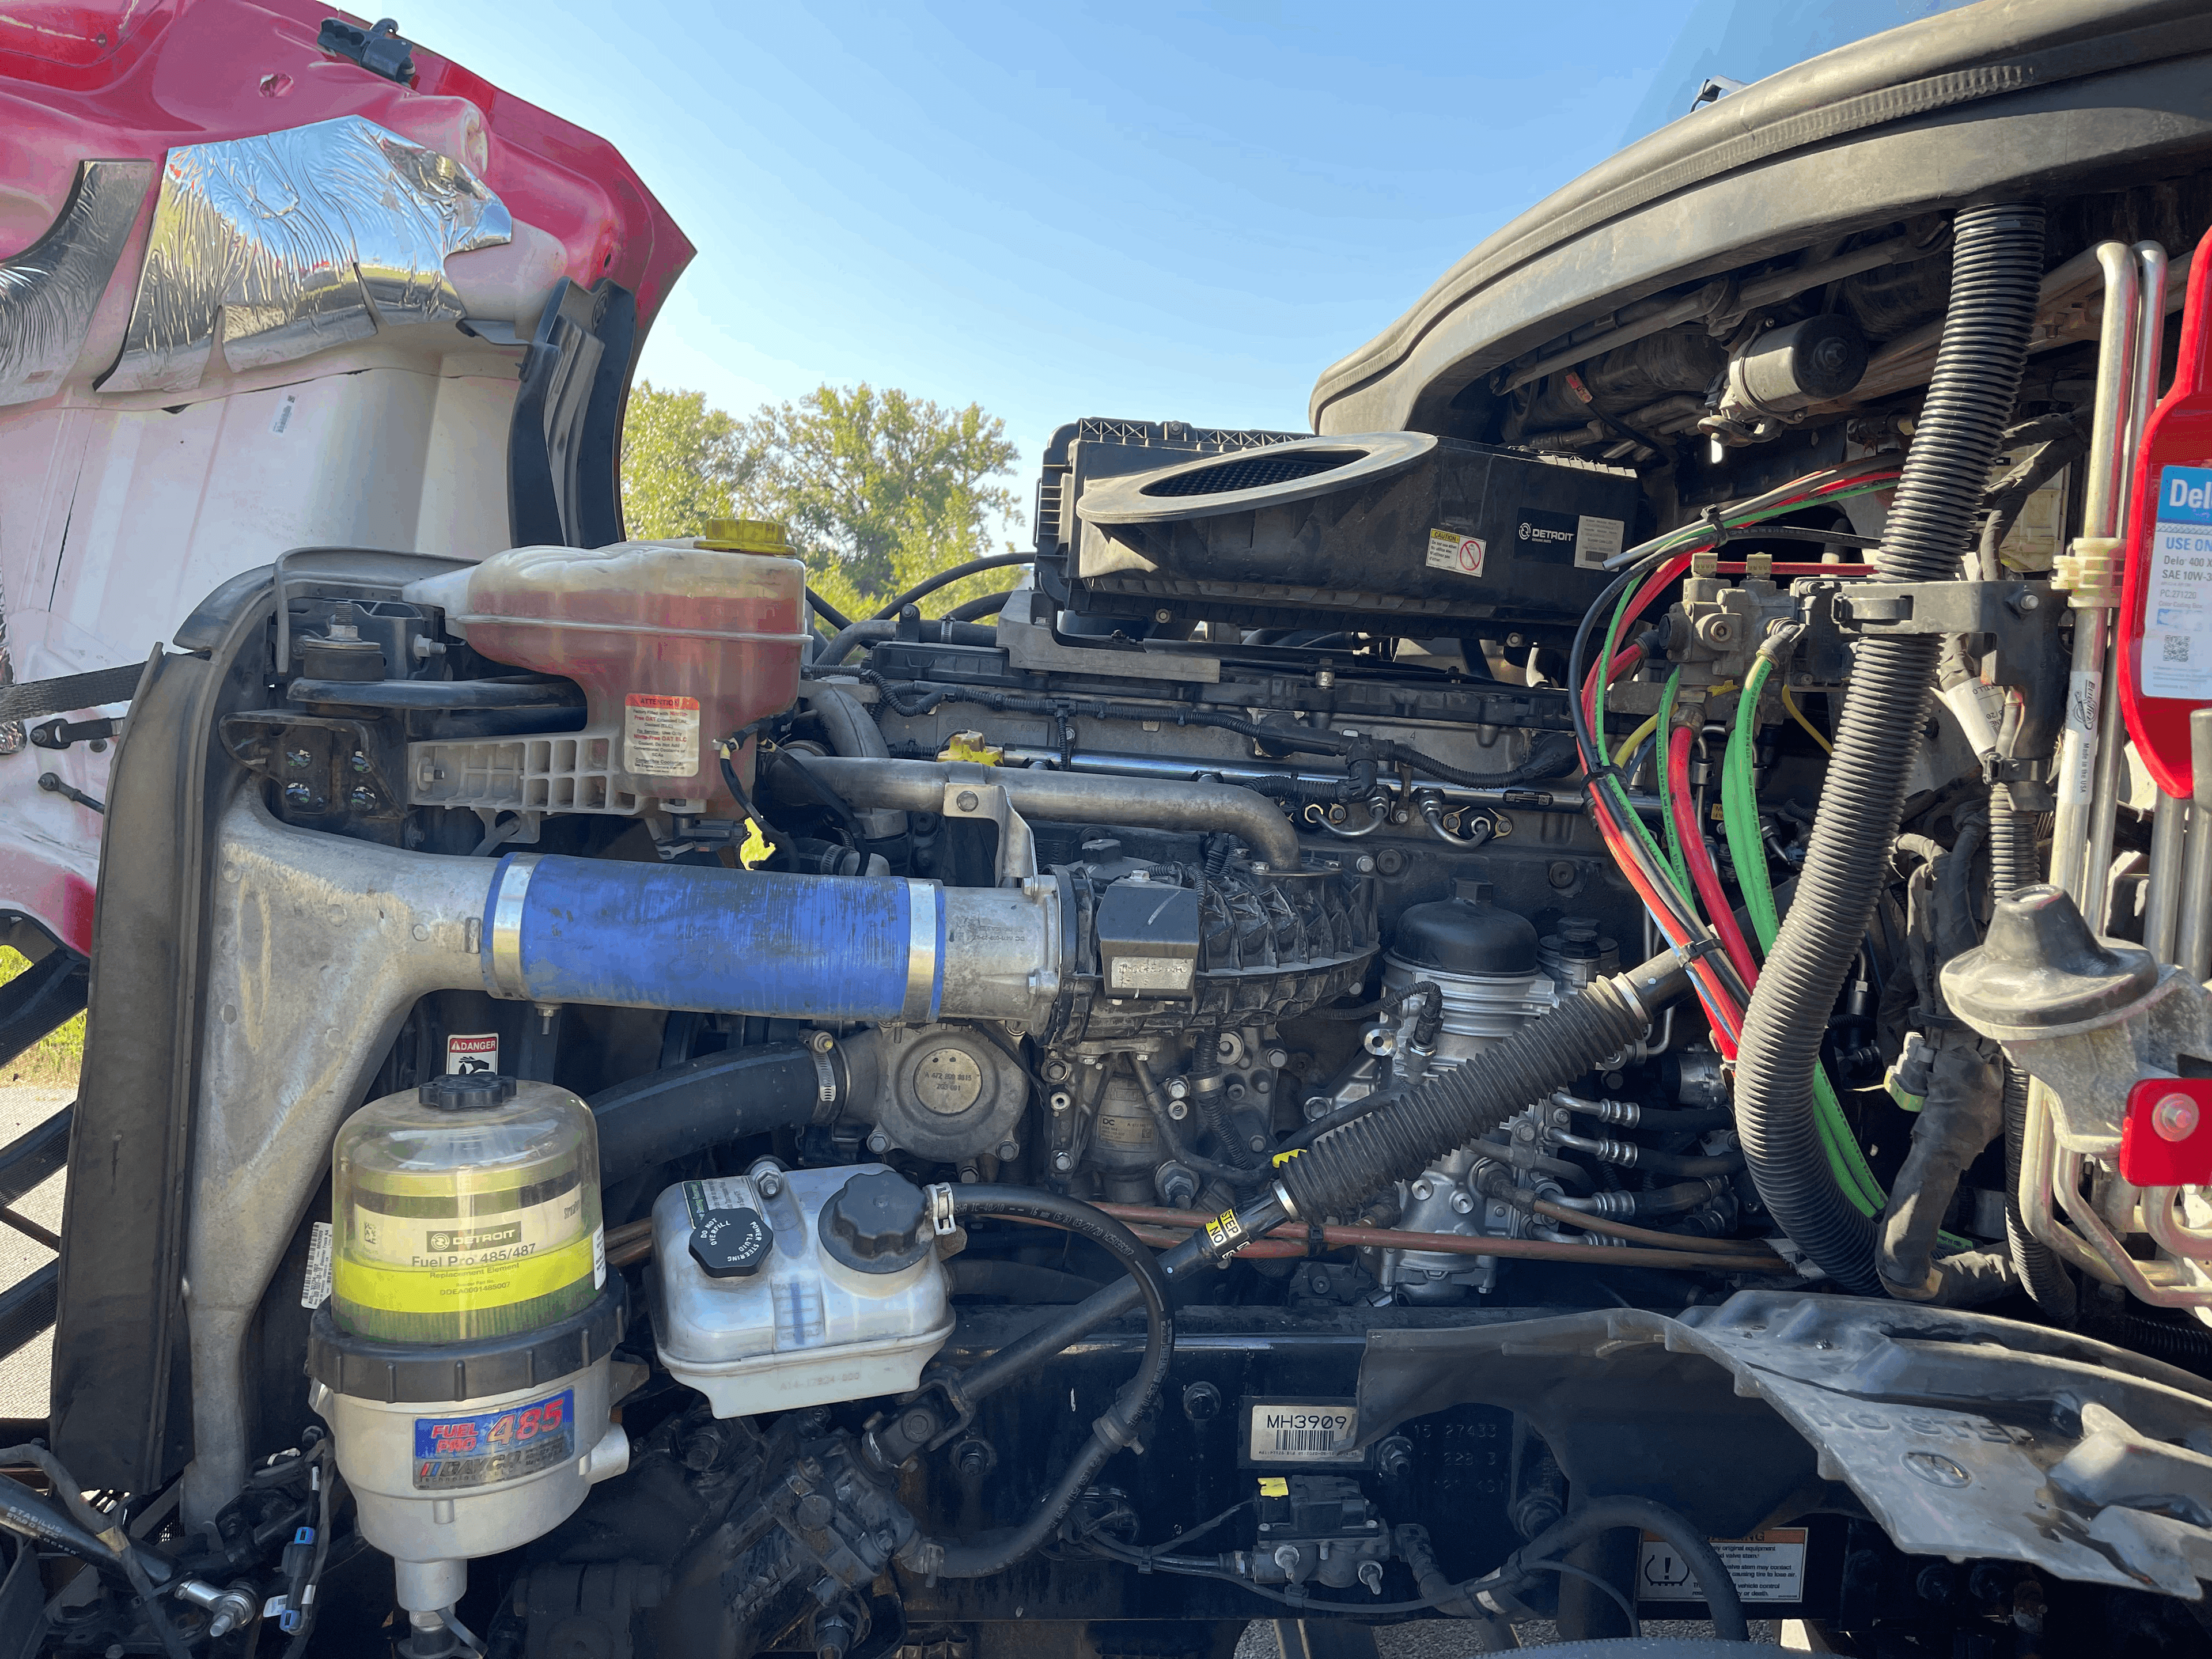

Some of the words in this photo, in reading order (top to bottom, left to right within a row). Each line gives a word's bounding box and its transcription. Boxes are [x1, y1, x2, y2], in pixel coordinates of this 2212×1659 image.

[1532, 528, 1575, 541] DETROIT
[2166, 537, 2191, 550] USE
[2189, 558, 2205, 567] 400
[2162, 569, 2181, 579] SAE
[461, 1040, 496, 1050] DANGER
[1103, 1118, 1115, 1126] DC
[700, 1230, 708, 1238] DO
[704, 1218, 718, 1229] NOT
[971, 1203, 1005, 1212] IC-40/10
[1052, 1211, 1072, 1225] (5/8)
[1072, 1219, 1103, 1237] 03/27/20
[1222, 1211, 1238, 1233] STEP
[453, 1229, 516, 1245] DETROIT
[709, 1220, 732, 1246] OVERFILL
[749, 1221, 762, 1241] POWER
[1210, 1226, 1224, 1243] NO
[738, 1233, 753, 1252] FLUID
[412, 1256, 442, 1268] Fuel
[448, 1256, 475, 1267] Pro
[480, 1243, 536, 1263] 485/487
[727, 1243, 759, 1262] STEERING
[430, 1269, 484, 1279] Replacement
[487, 1263, 520, 1274] Element
[487, 1397, 565, 1446] 485
[1267, 1414, 1347, 1430] MH3909
[1900, 1414, 2035, 1446] STEP
[431, 1422, 479, 1440] FUEL
[1445, 1424, 1497, 1438] 27433
[436, 1437, 477, 1453] PRO
[440, 1450, 522, 1478] DAYCO
[9, 1506, 63, 1533] STABILUS
